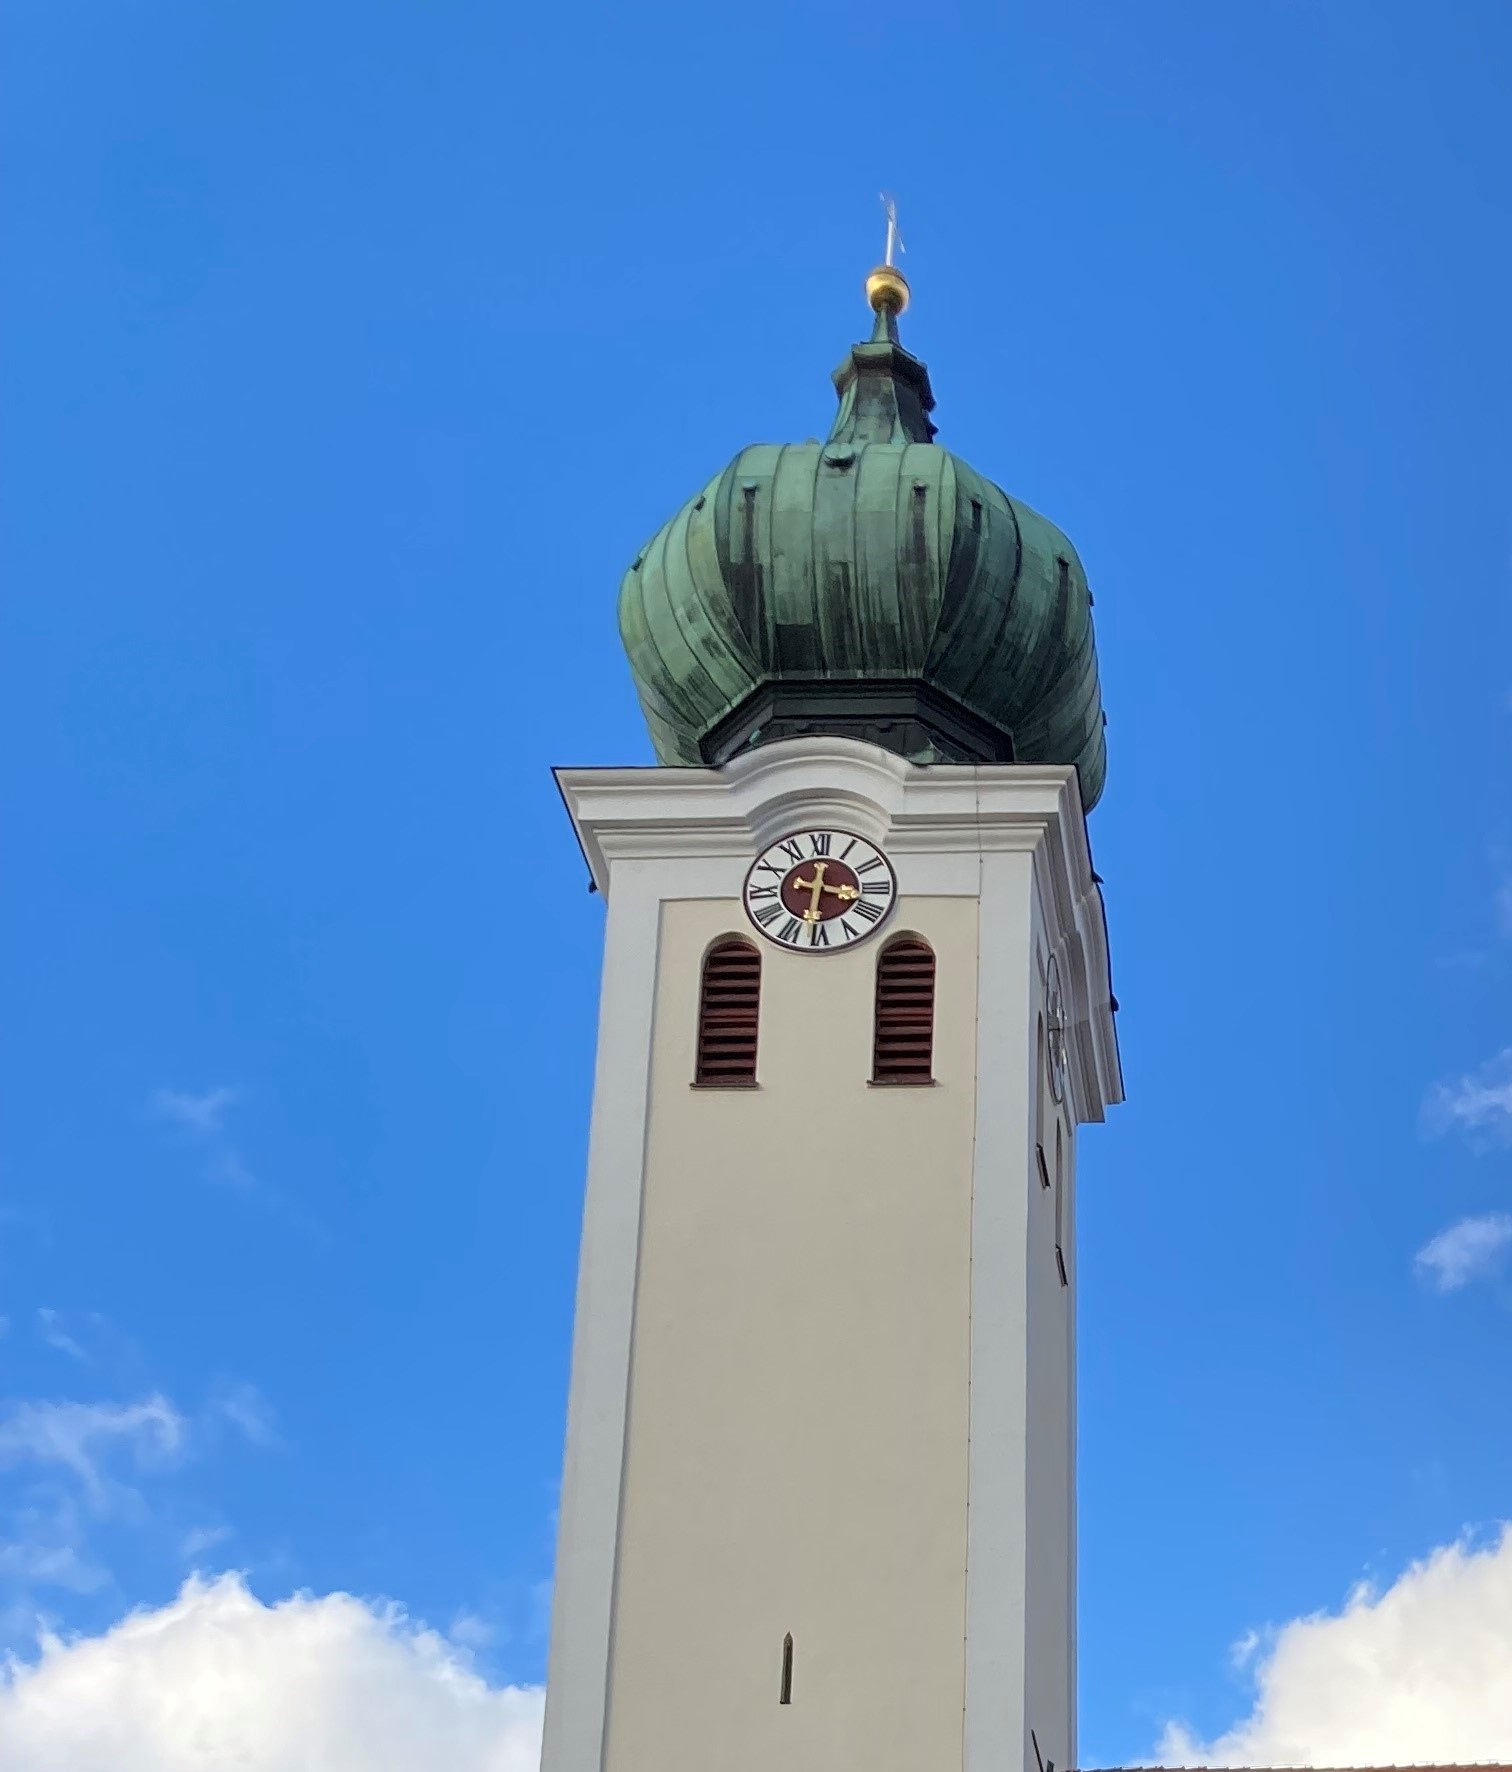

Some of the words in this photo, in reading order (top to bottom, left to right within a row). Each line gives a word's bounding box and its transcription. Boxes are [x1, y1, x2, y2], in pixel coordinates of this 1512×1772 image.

[778, 839, 805, 865] XI
[809, 833, 832, 856] XII
[839, 838, 859, 861] I
[757, 858, 787, 880] X
[854, 855, 884, 875] II
[749, 883, 778, 900] IX
[861, 879, 890, 895] III
[753, 901, 786, 928] VIII
[852, 899, 885, 923] IIII
[777, 916, 802, 944] VII
[810, 922, 831, 946] VI
[840, 917, 860, 940] V
